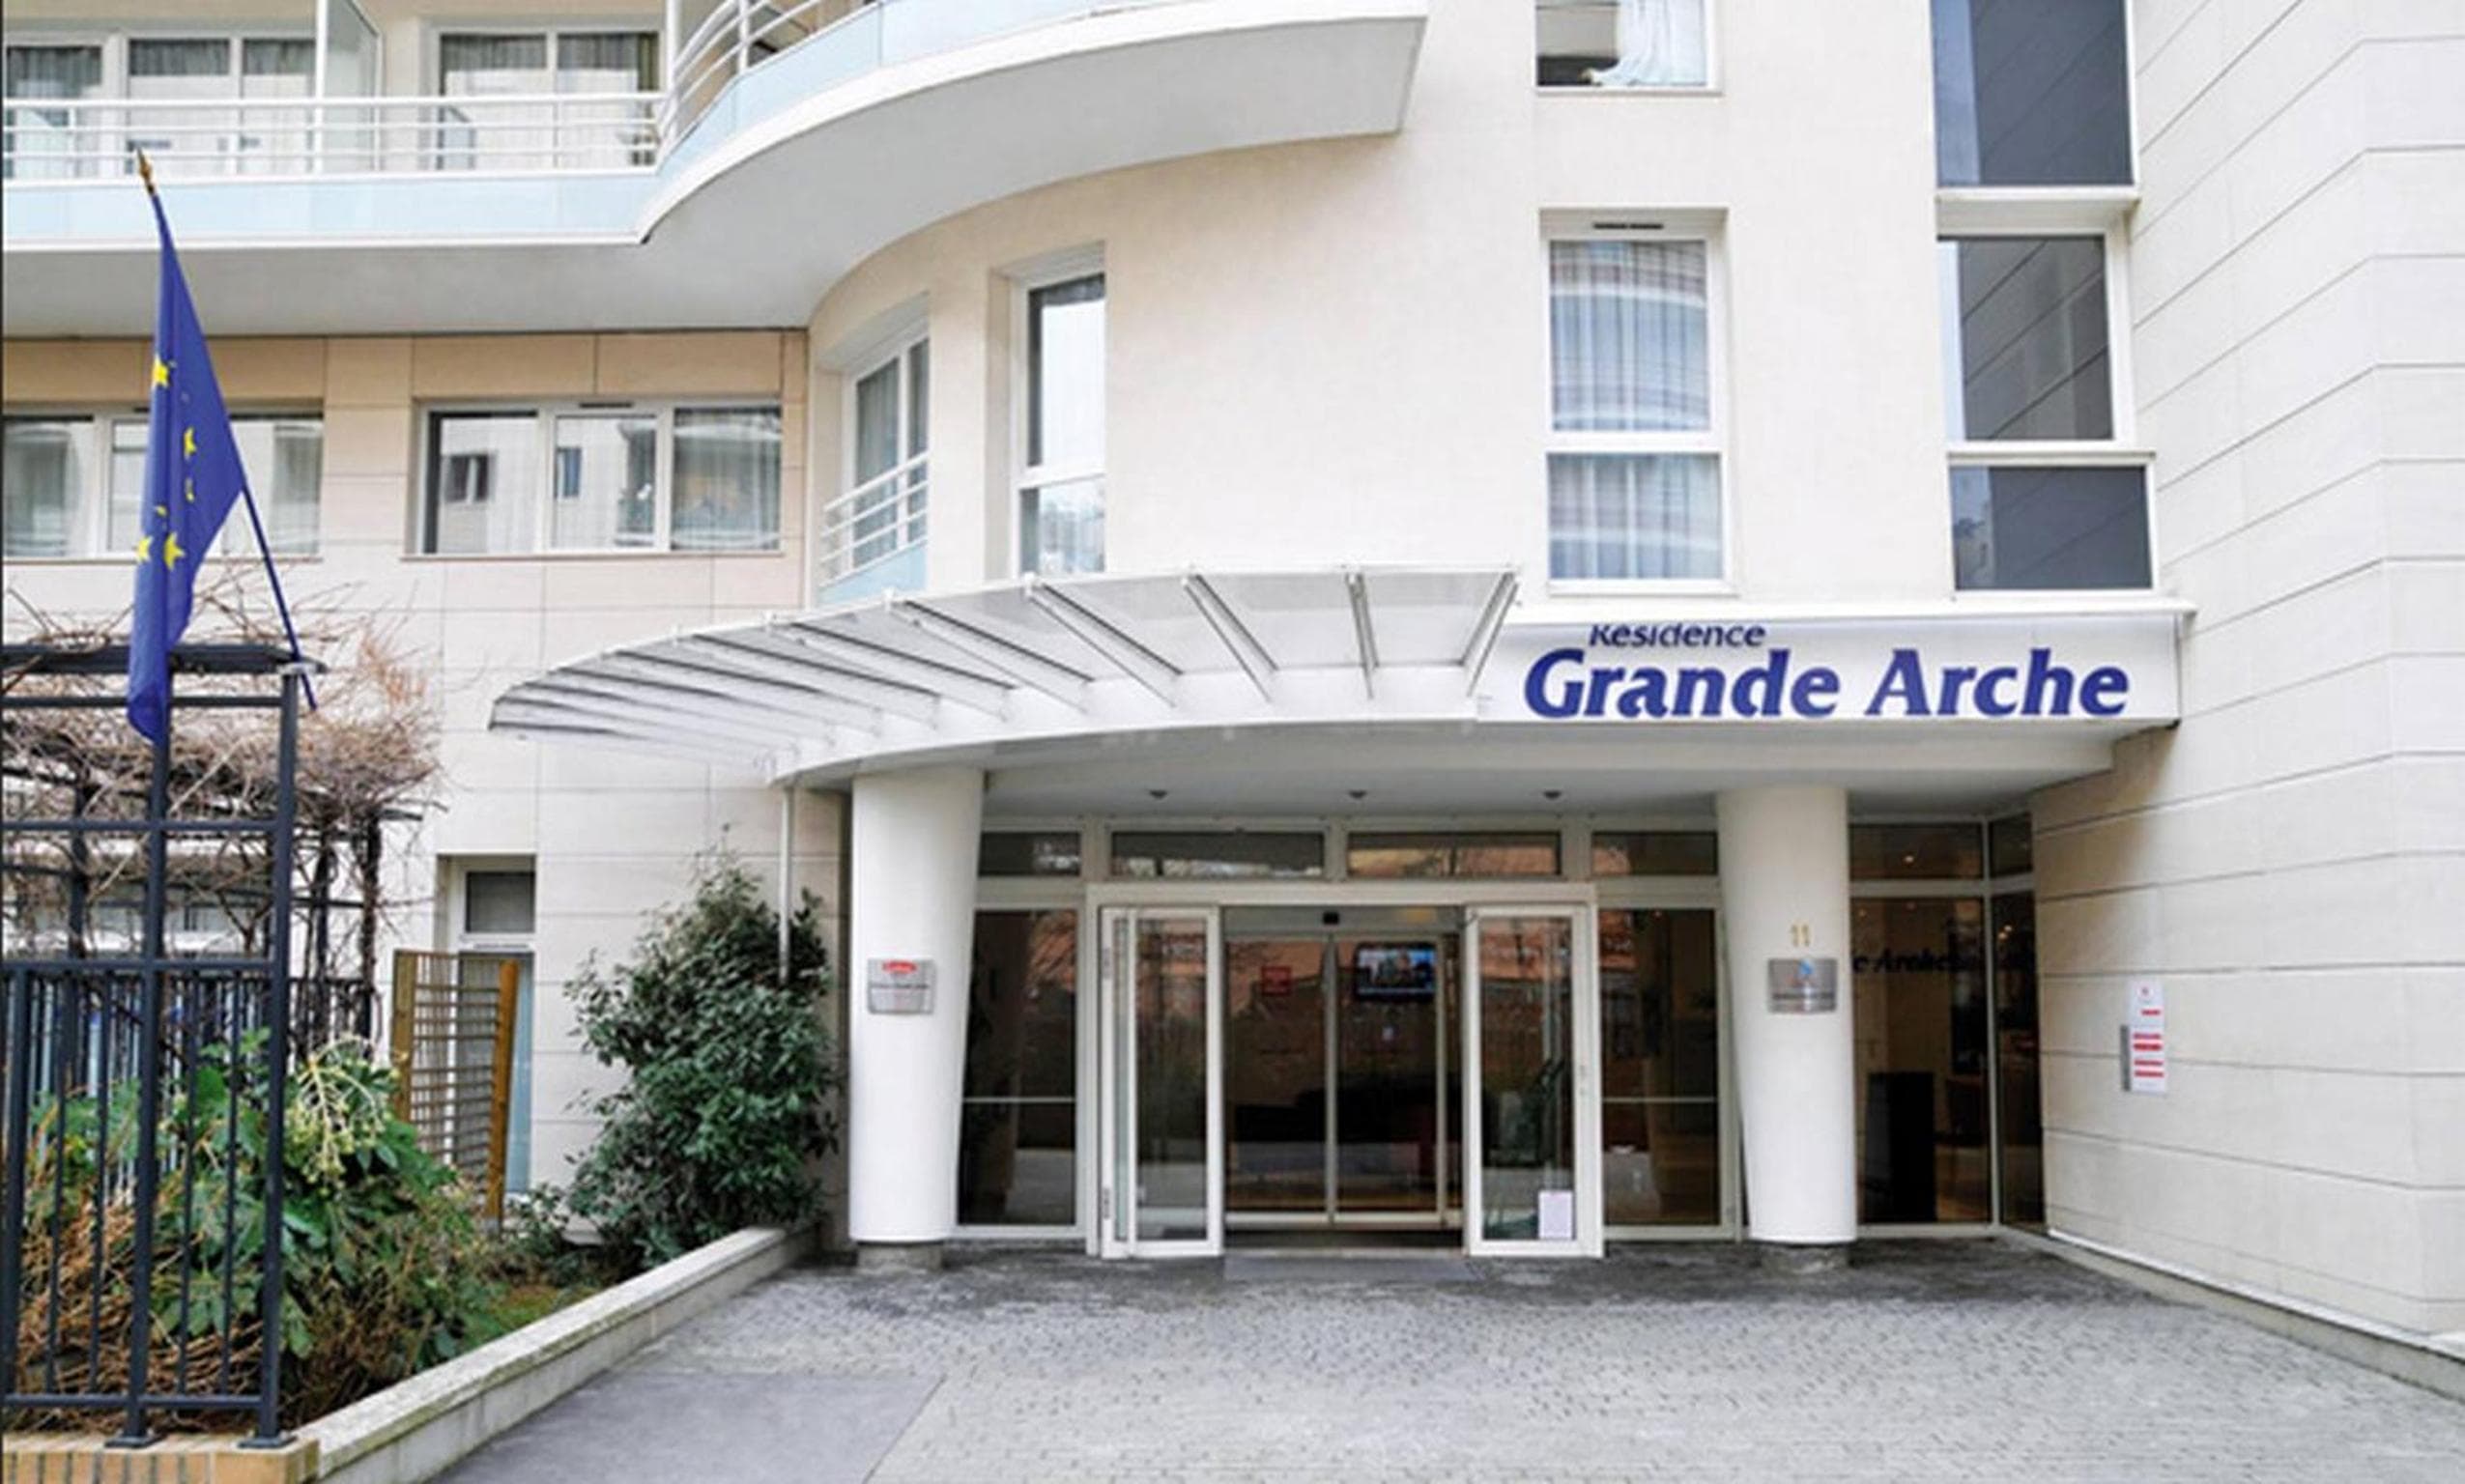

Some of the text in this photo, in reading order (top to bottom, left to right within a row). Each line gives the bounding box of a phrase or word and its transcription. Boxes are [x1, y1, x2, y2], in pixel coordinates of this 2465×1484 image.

[1524, 647, 2131, 719] Grande Arche
[1791, 924, 1810, 948] 11
